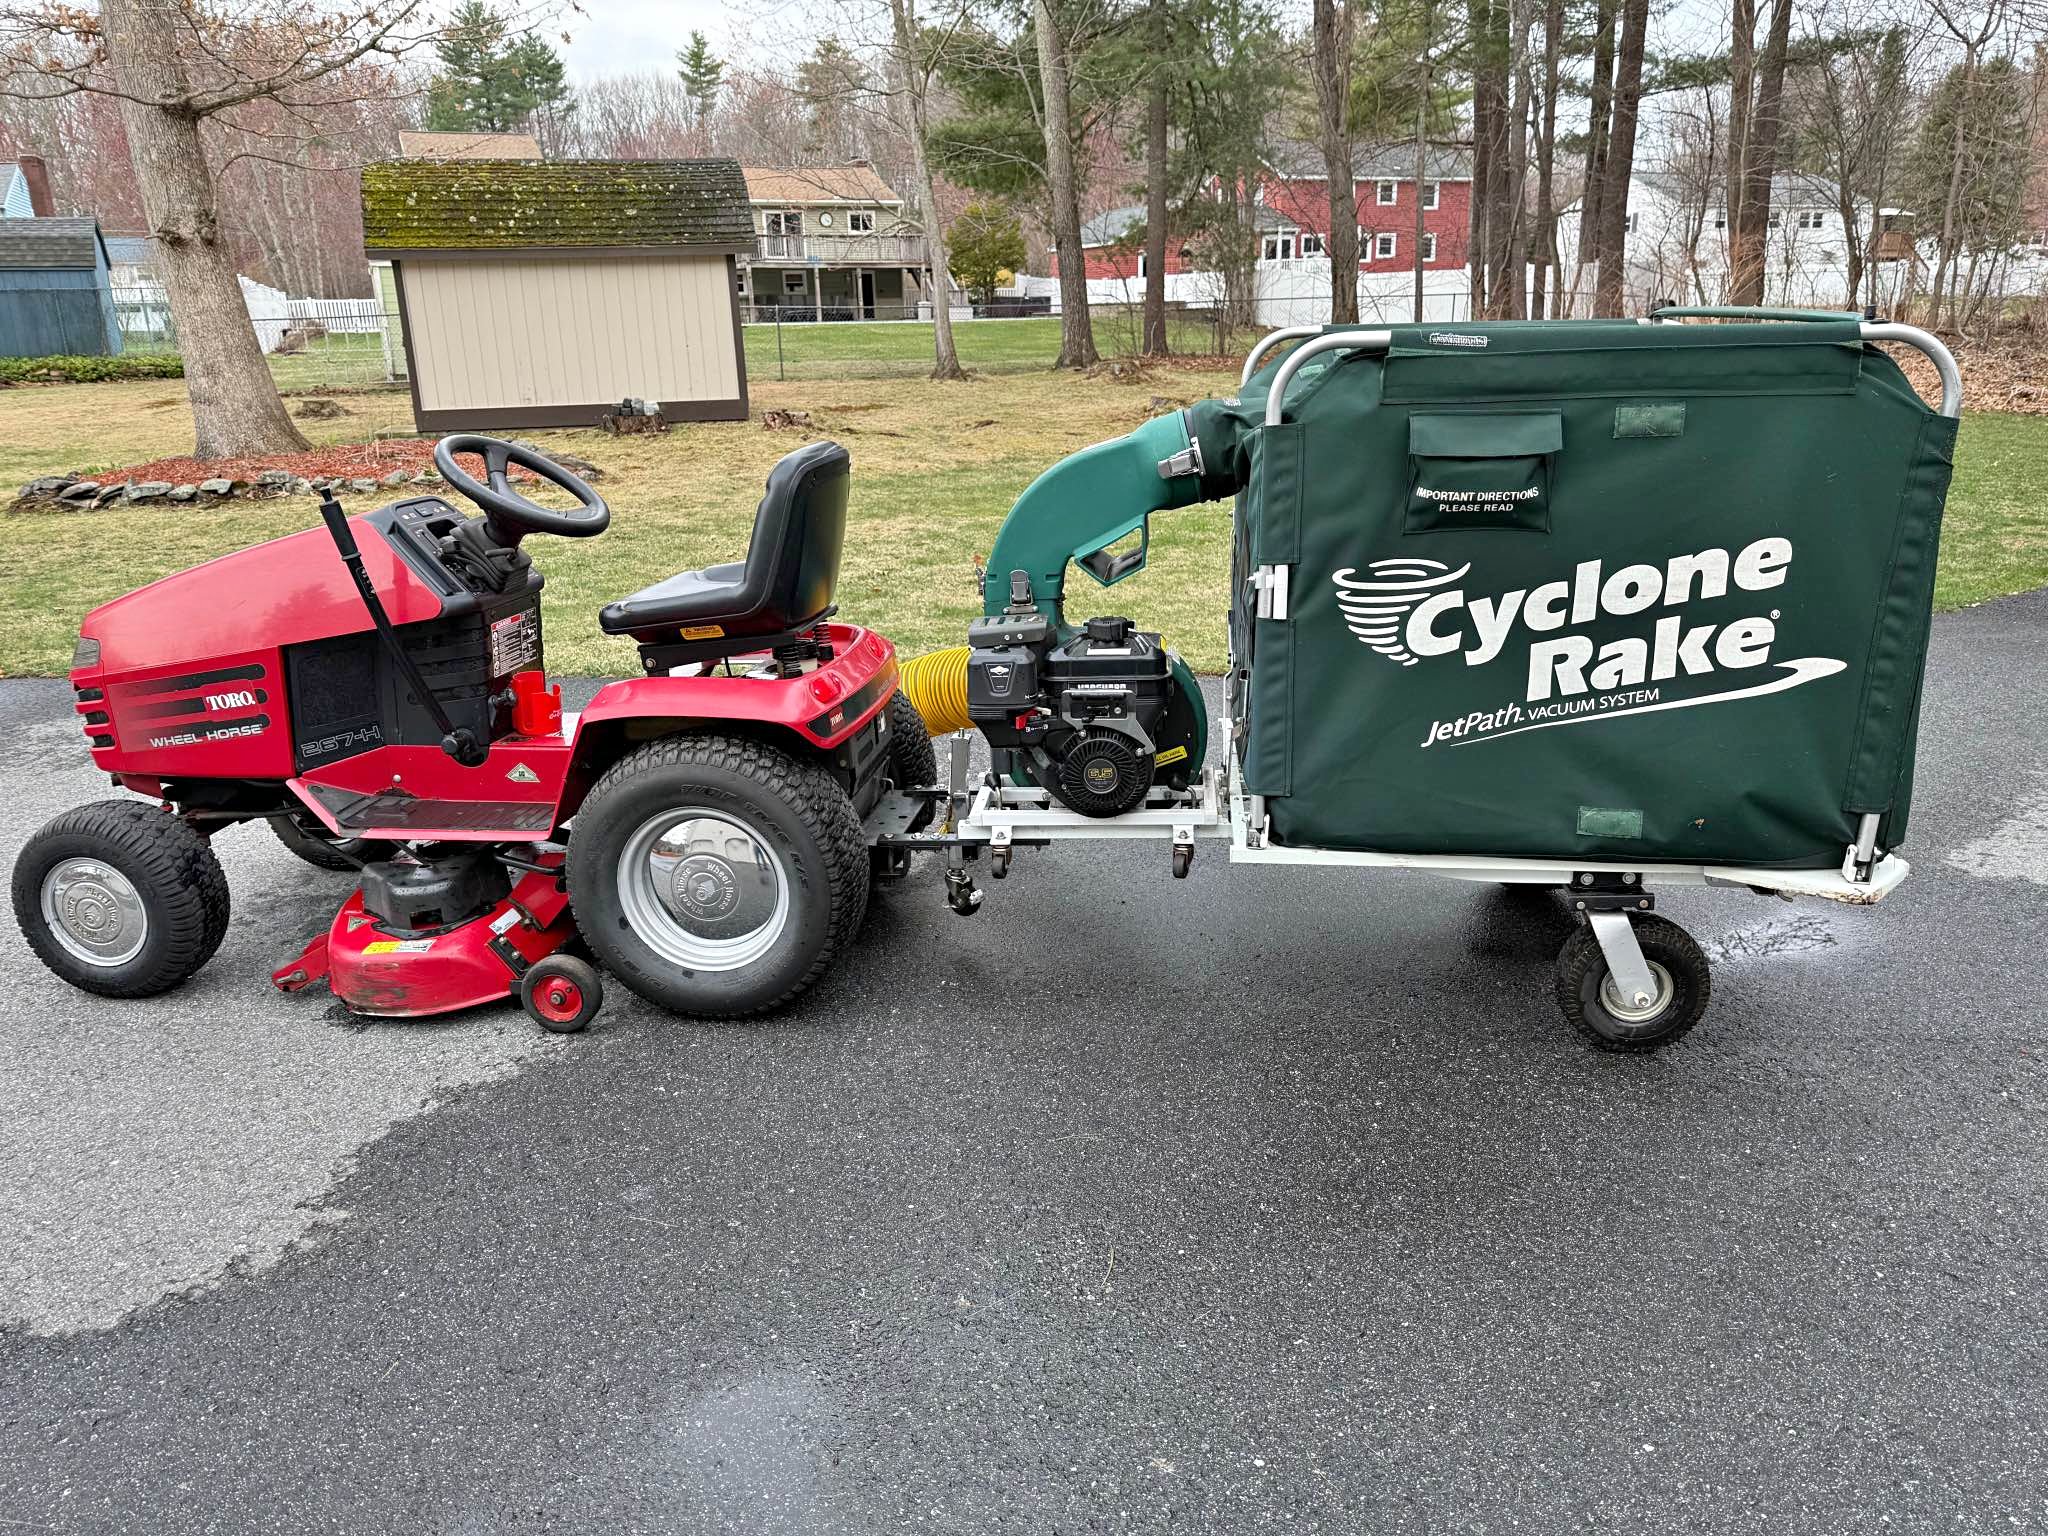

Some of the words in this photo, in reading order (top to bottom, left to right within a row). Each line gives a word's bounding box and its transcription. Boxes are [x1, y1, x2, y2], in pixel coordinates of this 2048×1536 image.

[1416, 487, 1475, 501] IMPORTANT
[1477, 487, 1539, 501] DIRECTIONS
[1439, 503, 1481, 512] PLEASE
[1484, 503, 1514, 512] READ
[1406, 537, 1793, 666] Cyclone
[206, 690, 256, 711] TORO
[1421, 702, 1521, 747] JetPath
[1528, 699, 1595, 721] VACUUM
[1599, 688, 1659, 709] SYSTEM
[150, 733, 203, 748] WHEEL
[206, 724, 263, 741] HORSE
[301, 725, 382, 757] 267-H
[706, 861, 733, 885] Wheel
